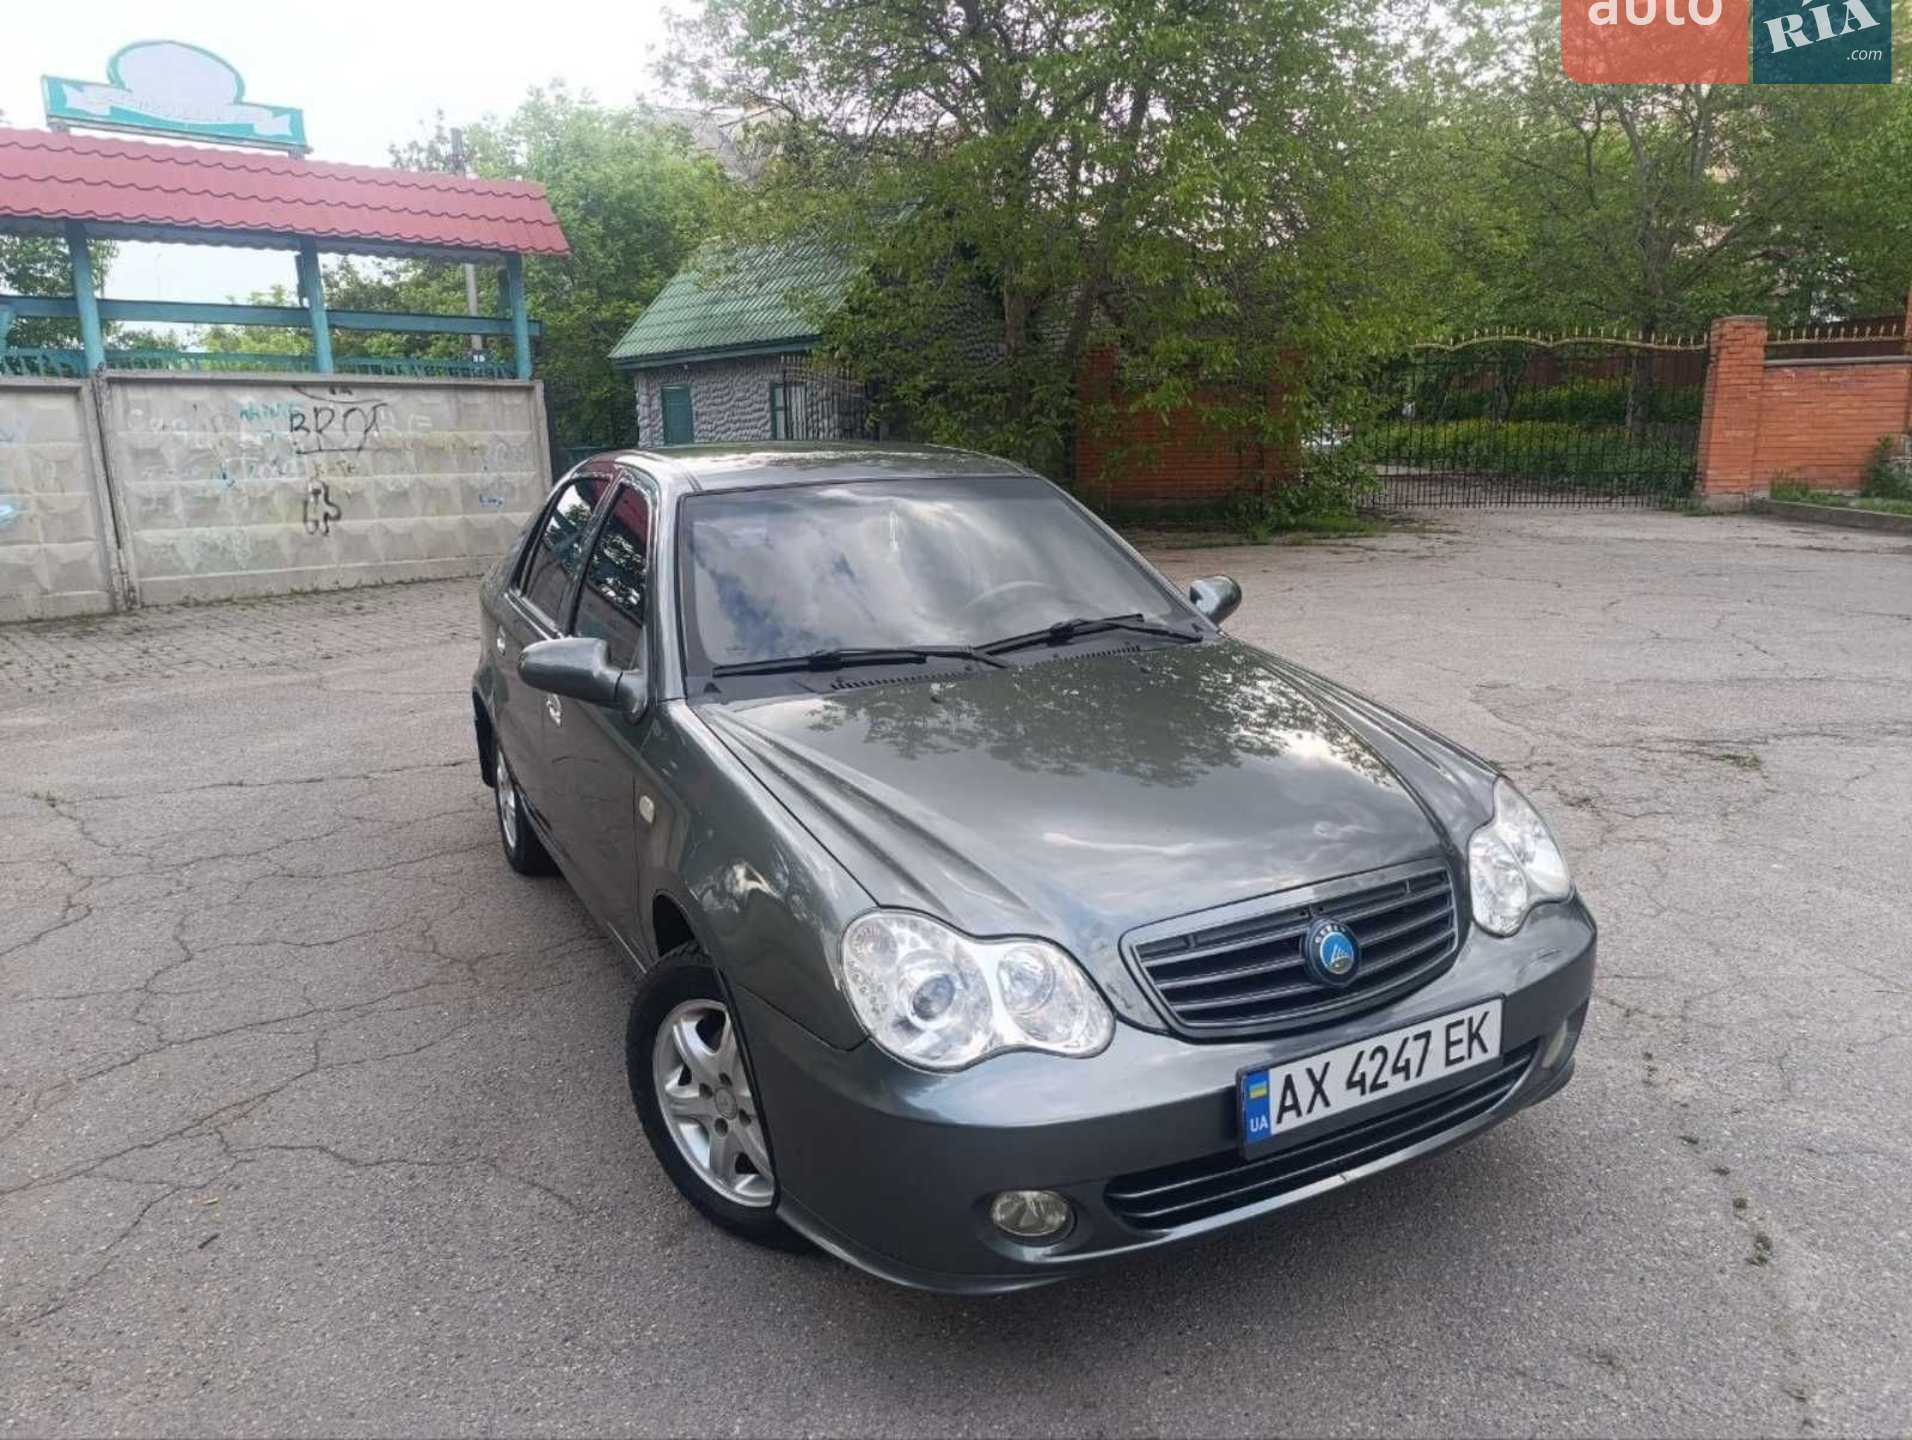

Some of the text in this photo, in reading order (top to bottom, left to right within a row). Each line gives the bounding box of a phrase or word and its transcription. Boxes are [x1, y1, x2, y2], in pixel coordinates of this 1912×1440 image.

[1276, 1011, 1490, 1124] AX 4247 EK
[1250, 1118, 1269, 1132] UA
